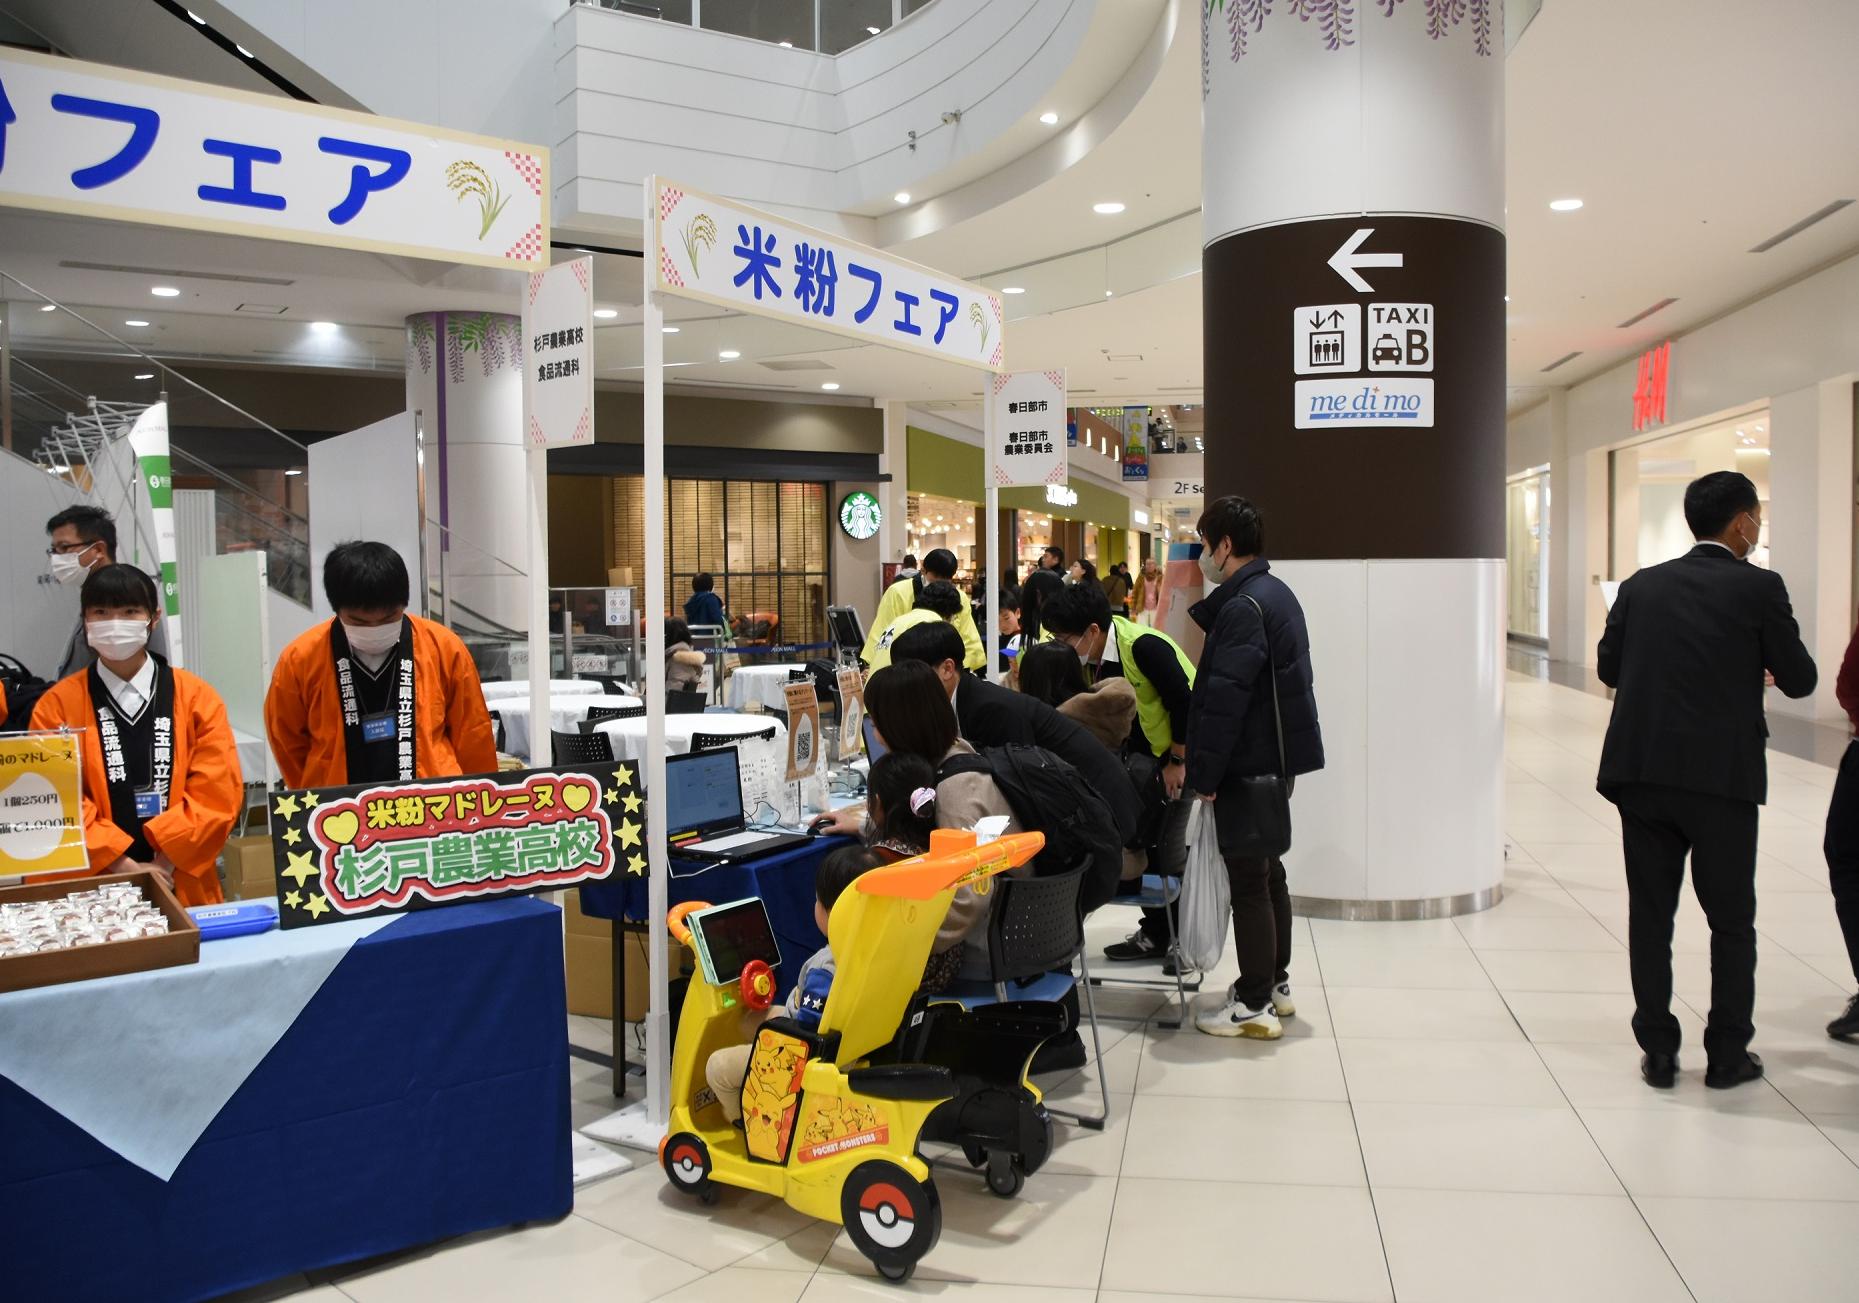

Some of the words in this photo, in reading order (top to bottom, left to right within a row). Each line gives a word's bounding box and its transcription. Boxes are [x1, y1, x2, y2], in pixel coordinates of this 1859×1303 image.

[0, 78, 412, 225] フェア
[733, 224, 960, 345] 米粉フェア
[1373, 308, 1428, 324] TAXI
[533, 326, 584, 353] 杉戸農業高校
[1406, 329, 1429, 365] B
[538, 357, 579, 382] 食品流通科
[1008, 400, 1048, 414] 春日部市
[1004, 442, 1054, 456] 農業委員会
[1009, 430, 1049, 443] 春日部市
[1174, 481, 1189, 494] 2F
[336, 658, 359, 726] 食品流通科
[98, 706, 127, 783] 食品流通科
[4, 793, 58, 807] 1個250円
[367, 785, 556, 829] 米粉マドレーヌ
[338, 817, 602, 897] 杉戸農業高校
[812, 1142, 839, 1157] POCKET
